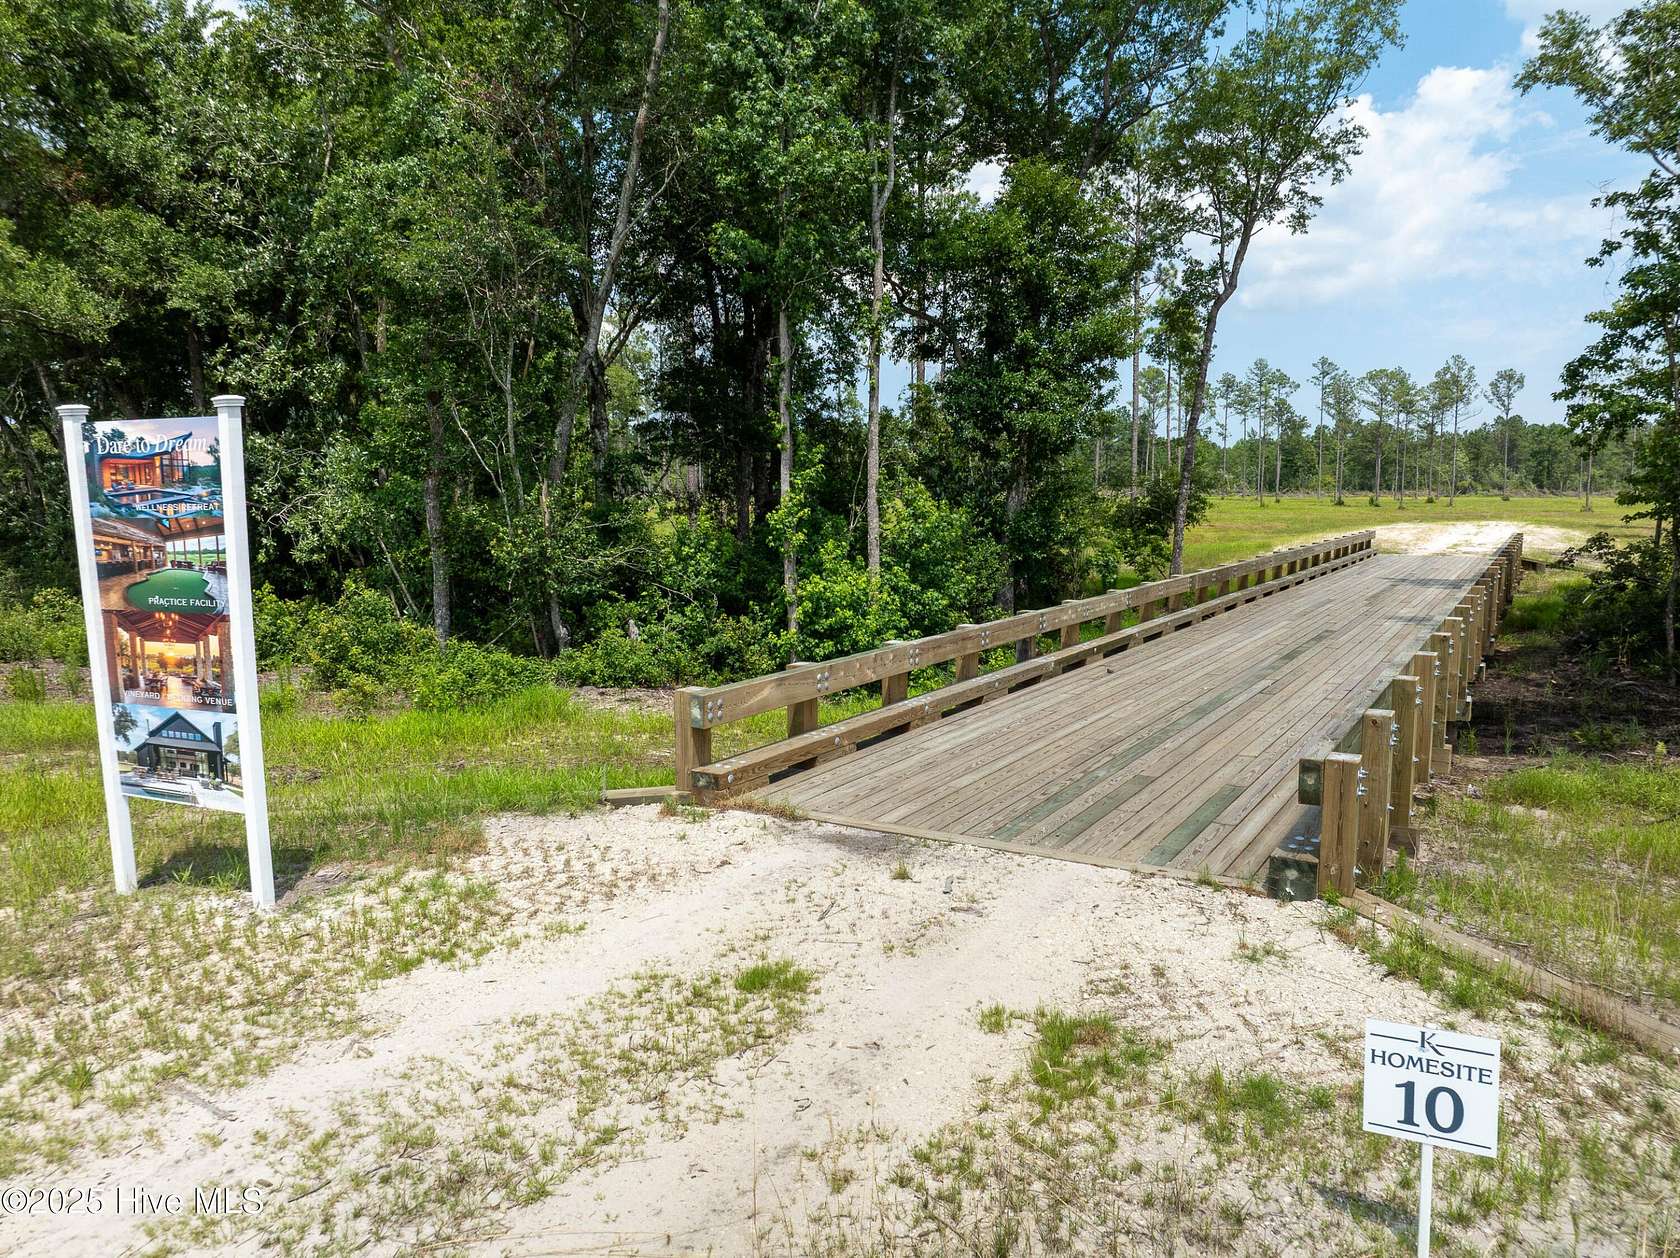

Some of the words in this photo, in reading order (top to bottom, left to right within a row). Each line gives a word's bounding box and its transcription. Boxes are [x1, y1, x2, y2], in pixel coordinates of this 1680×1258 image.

[96, 434, 132, 455] Dare
[138, 437, 150, 454] to
[136, 503, 179, 512] WELLNESS
[181, 502, 219, 511] RETREAT
[147, 596, 188, 606] PRACTICE
[189, 598, 226, 608] FACILITY
[122, 689, 161, 700] VINEYARD
[205, 697, 233, 707] VENUE
[1420, 1031, 1445, 1056] K
[1370, 1049, 1493, 1085] HOMESITE
[1395, 1080, 1465, 1134] 10
